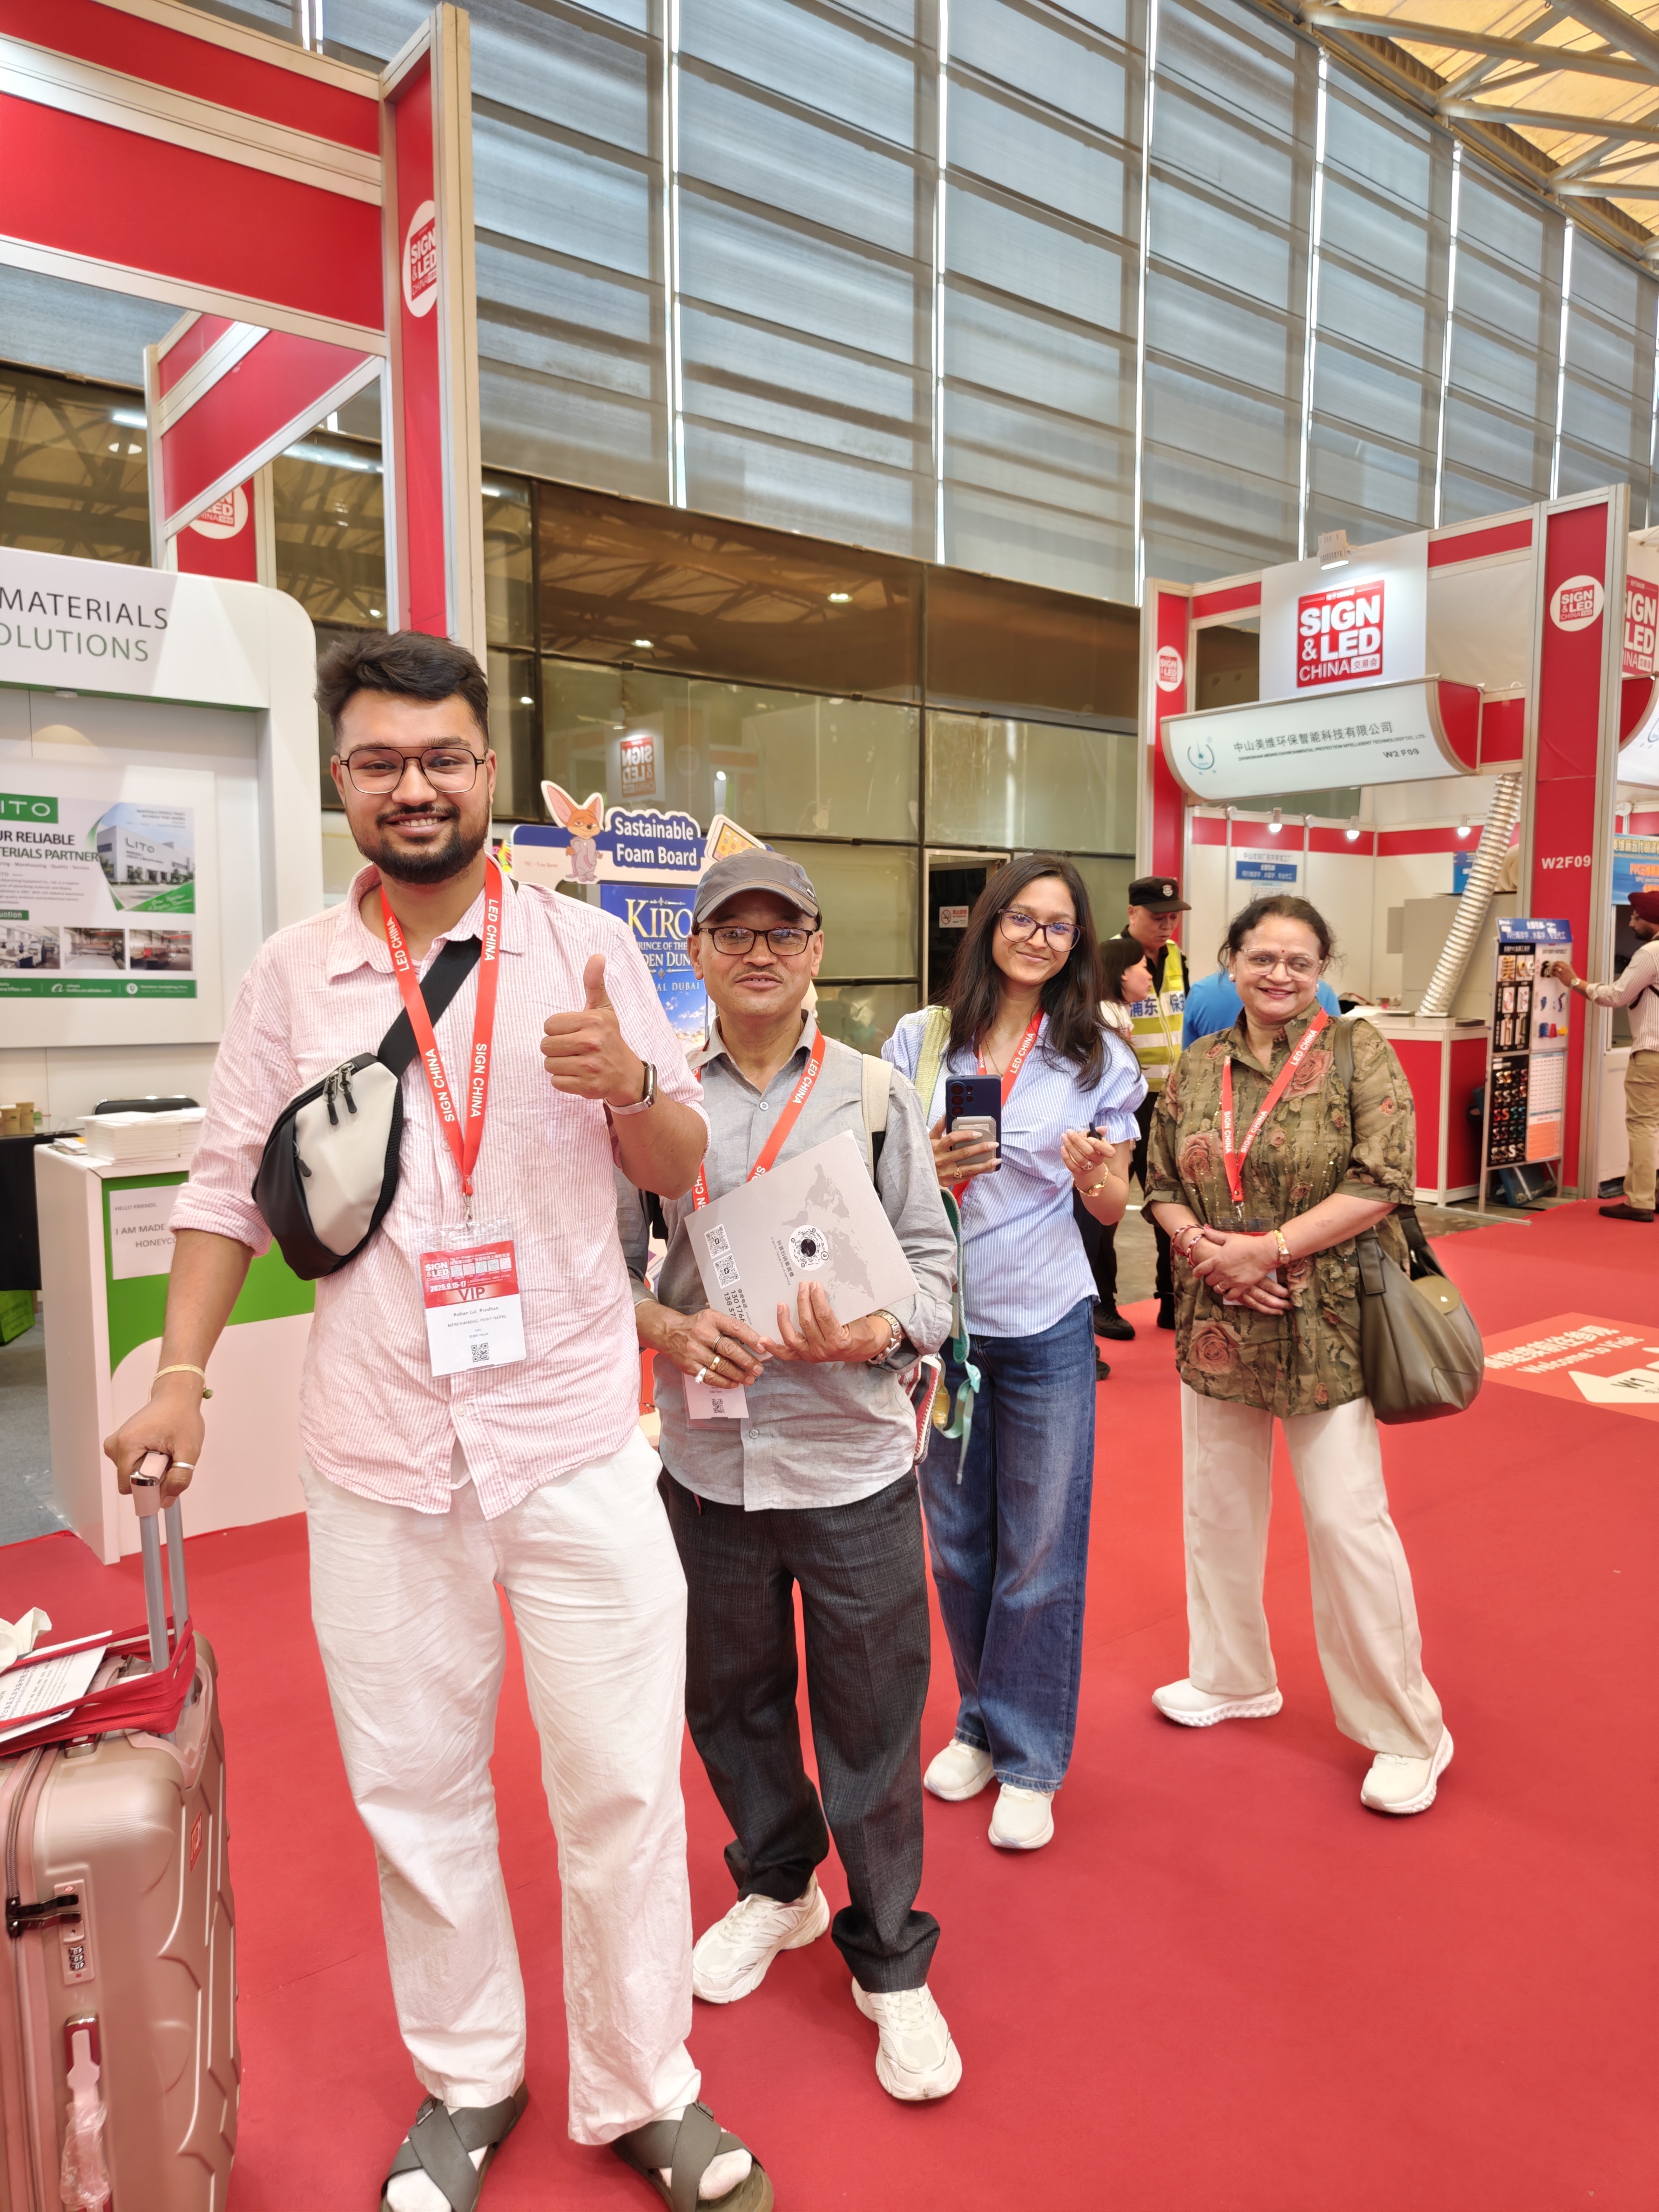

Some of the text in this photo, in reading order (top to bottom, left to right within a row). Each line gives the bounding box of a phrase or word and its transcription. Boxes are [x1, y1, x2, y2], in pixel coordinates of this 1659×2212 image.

[411, 227, 435, 265] SIGN
[417, 249, 436, 279] LED
[0, 586, 168, 630] MATERIALS
[1561, 589, 1593, 605] SIGN
[1562, 605, 1568, 613] &
[1569, 600, 1593, 613] LED
[1624, 590, 1652, 627] IGN
[1299, 595, 1380, 637] SIGN
[1560, 611, 1581, 621] CHINA
[1302, 626, 1381, 662] & LED
[1624, 622, 1655, 655] LED
[1299, 659, 1350, 682] CHINA
[1353, 658, 1378, 670] 交易会
[1233, 721, 1393, 753] 中山美维环保智能科技有限公司
[1382, 748, 1419, 758] W2 F09
[16, 831, 75, 846] RELIABLE
[615, 817, 693, 840] Sastainable
[45, 849, 99, 862] PARTNER
[125, 837, 155, 853] LITO
[617, 843, 697, 866] Foam Board
[1541, 855, 1591, 869] W2F09
[484, 899, 498, 961] LED CHINA
[386, 916, 410, 972] LED CHINA
[637, 941, 687, 950] RINCE OF THE
[666, 952, 692, 967] DUN
[672, 981, 700, 991] DUBAI
[1129, 997, 1158, 1017] 浦东
[1009, 1033, 1035, 1074] LED CHINA
[1290, 1030, 1318, 1066] LED CHINA
[425, 1048, 455, 1122] SIGN CHINA
[470, 1043, 487, 1117] SIGN CHINA
[792, 1058, 819, 1104] LED CHINA
[1223, 1110, 1233, 1155] SIGN CHINA
[1240, 1110, 1268, 1154] SIGN CHINA
[122, 1226, 136, 1235] AM
[139, 1223, 165, 1232] MADE
[425, 1262, 448, 1271] SIGN
[777, 1240, 794, 1277] 抖音扫码看直播
[432, 1269, 449, 1277] LED
[458, 1286, 485, 1301] VIP
[724, 1292, 732, 1306] 138
[731, 1290, 739, 1304] 130
[1516, 1336, 1644, 1374] Welcome to Visit
[1610, 1377, 1655, 1389] W1
